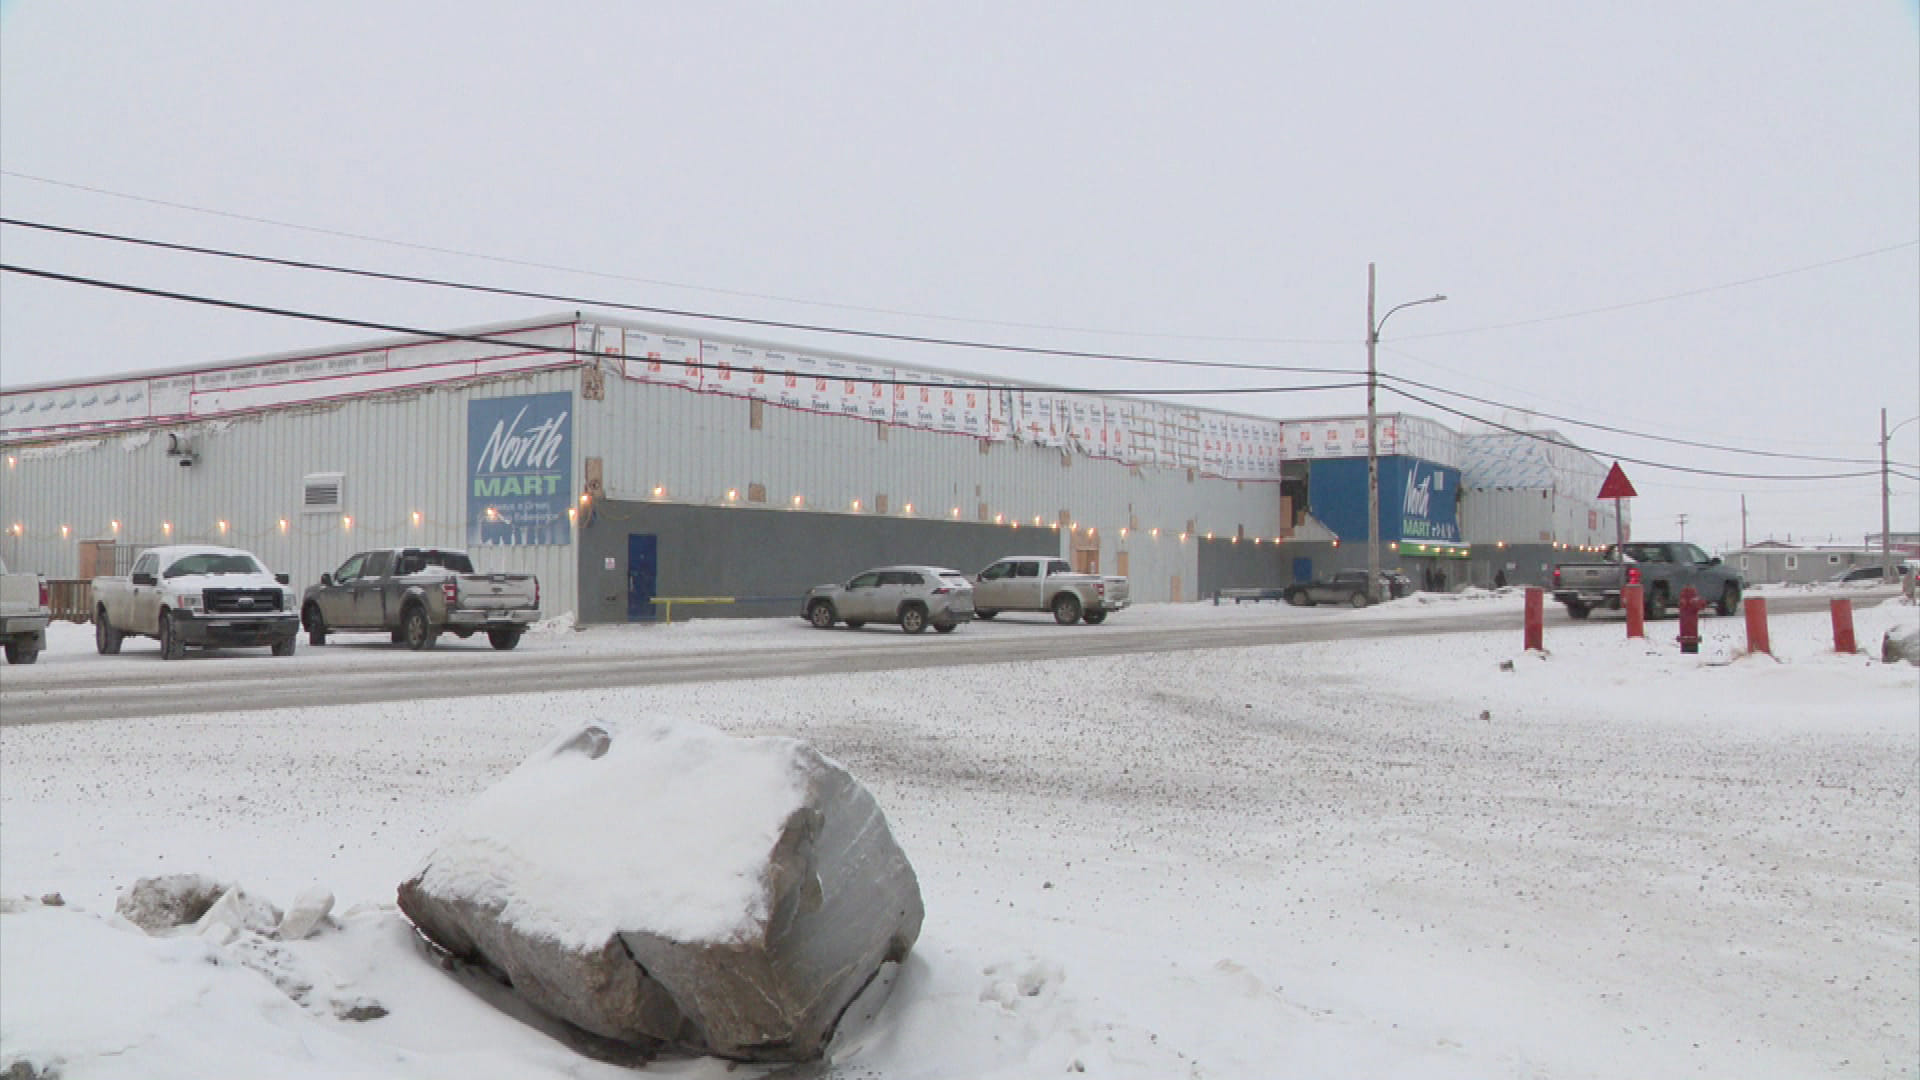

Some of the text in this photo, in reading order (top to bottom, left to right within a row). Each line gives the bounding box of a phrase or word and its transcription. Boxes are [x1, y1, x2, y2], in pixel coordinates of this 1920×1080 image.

[477, 403, 568, 473] North
[473, 475, 562, 497] MART
[1403, 459, 1431, 519] North
[1403, 518, 1431, 537] MART
